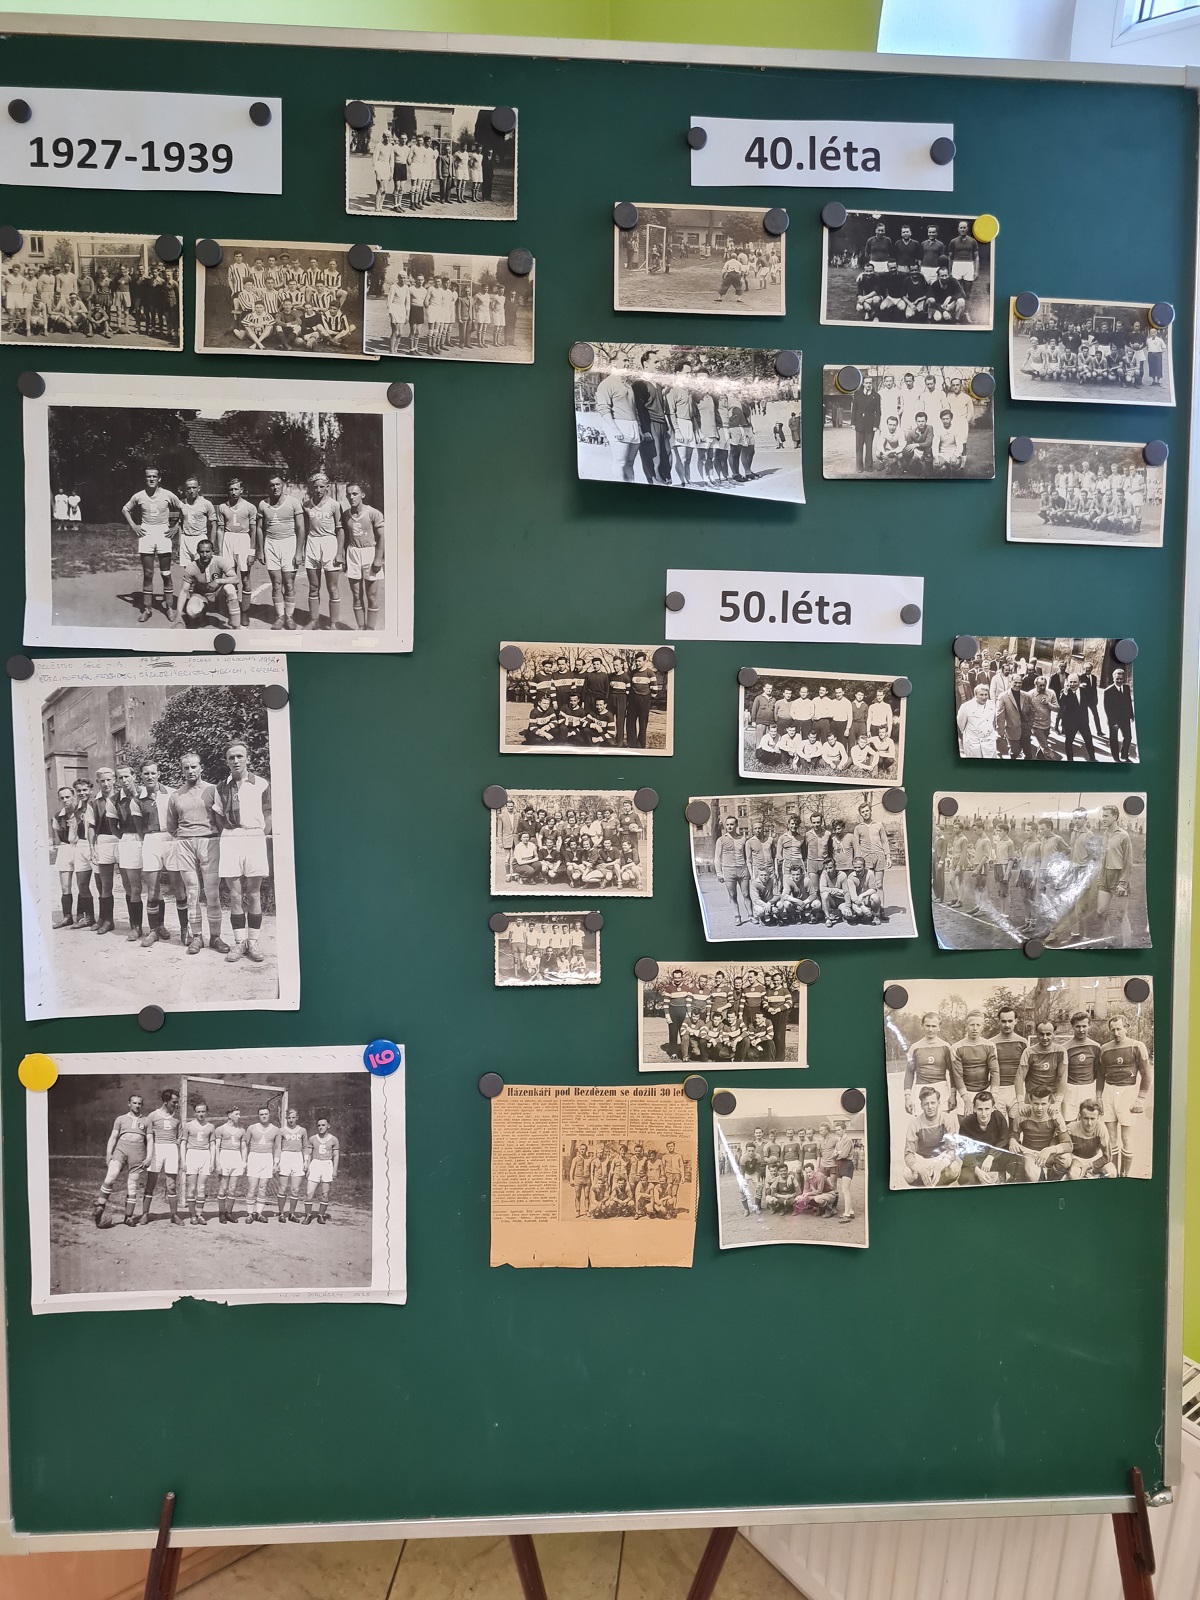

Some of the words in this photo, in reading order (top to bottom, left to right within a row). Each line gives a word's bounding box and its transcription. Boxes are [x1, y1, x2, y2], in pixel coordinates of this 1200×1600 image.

[29, 137, 234, 174] 1927-1939
[745, 136, 881, 173] 40.léta
[718, 590, 852, 626] 50.léta
[507, 1087, 551, 1097] Házenkáři
[555, 1087, 571, 1098] pod
[574, 1087, 617, 1097] Bezdězem
[620, 1089, 630, 1097] se
[633, 1087, 657, 1097] dožili
[660, 1088, 671, 1097] 30
